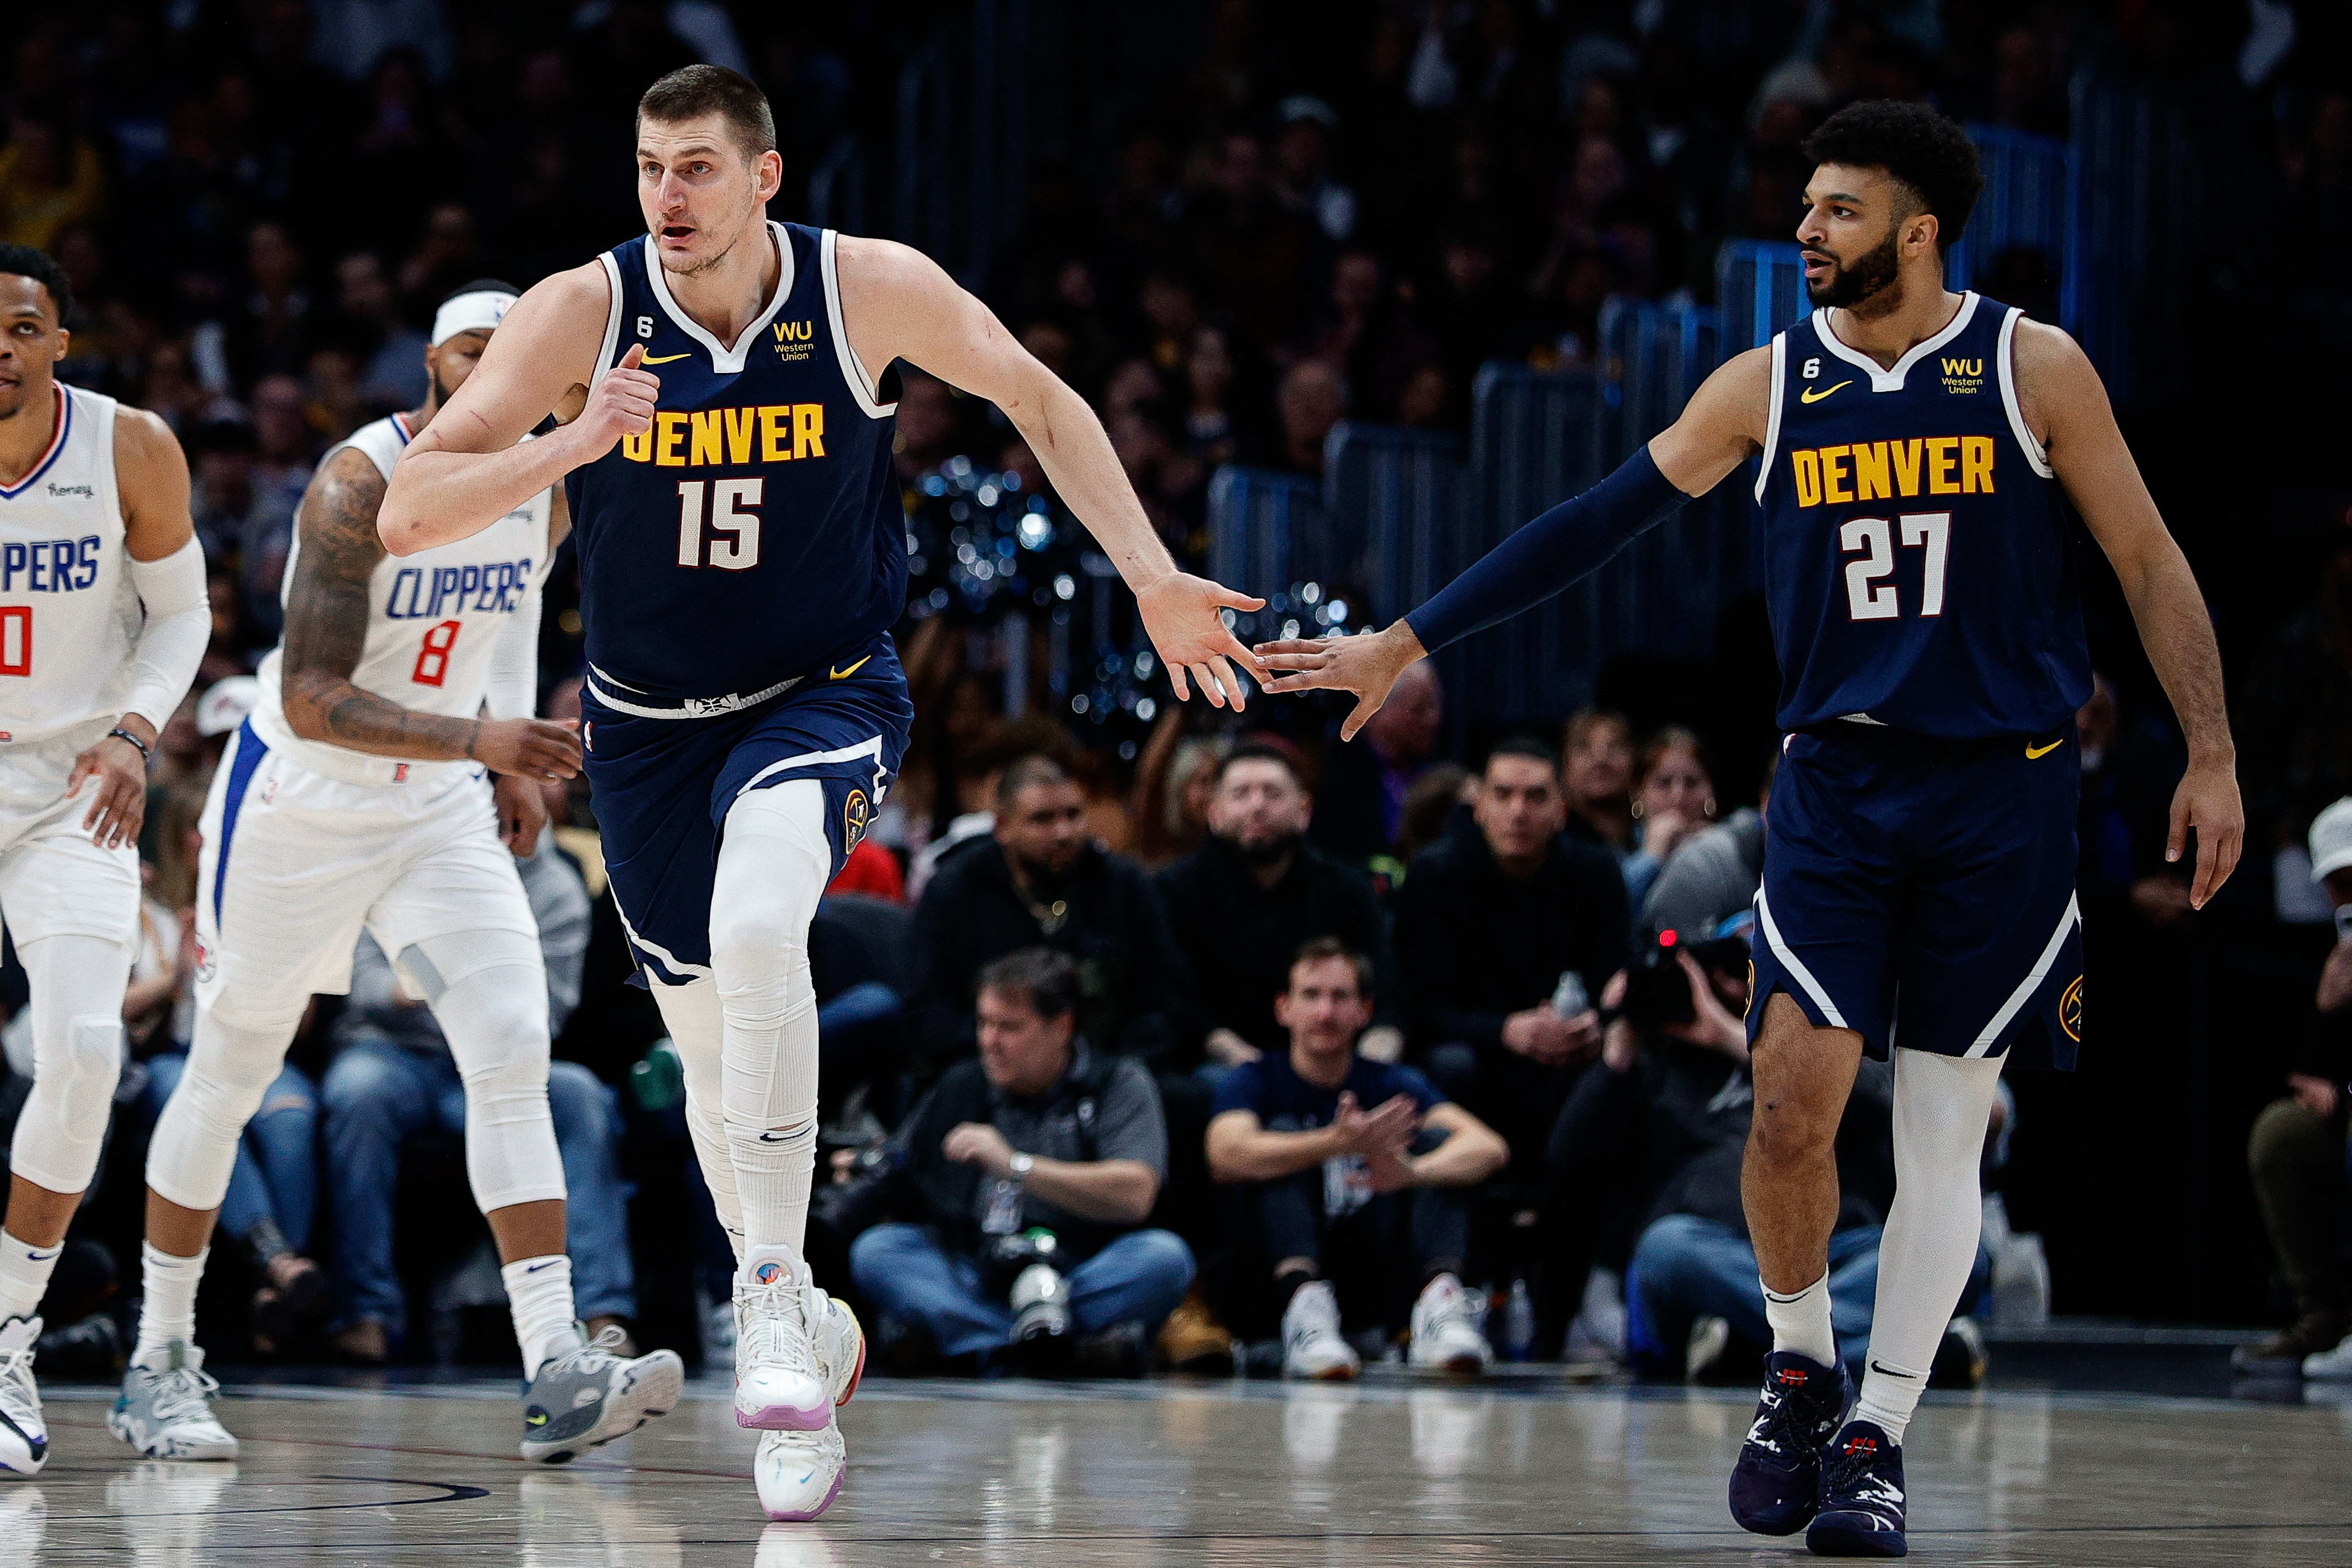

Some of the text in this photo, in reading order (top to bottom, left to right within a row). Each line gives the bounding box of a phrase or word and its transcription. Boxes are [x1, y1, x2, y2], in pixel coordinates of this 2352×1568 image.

[636, 315, 653, 338] 6
[773, 320, 812, 342] WU
[774, 343, 814, 353] Western
[781, 352, 809, 361] Union
[1802, 357, 1821, 378] 6
[1941, 357, 1983, 376] WU
[1941, 377, 1983, 386] Western
[1948, 385, 1977, 394] Union
[1791, 435, 1996, 509] DENVER
[675, 476, 766, 572] 15
[2, 535, 101, 593] PERS
[1839, 510, 1952, 621] 27
[385, 557, 532, 620] CLIPPERS
[0, 605, 32, 678] 0
[411, 619, 464, 688] 8
